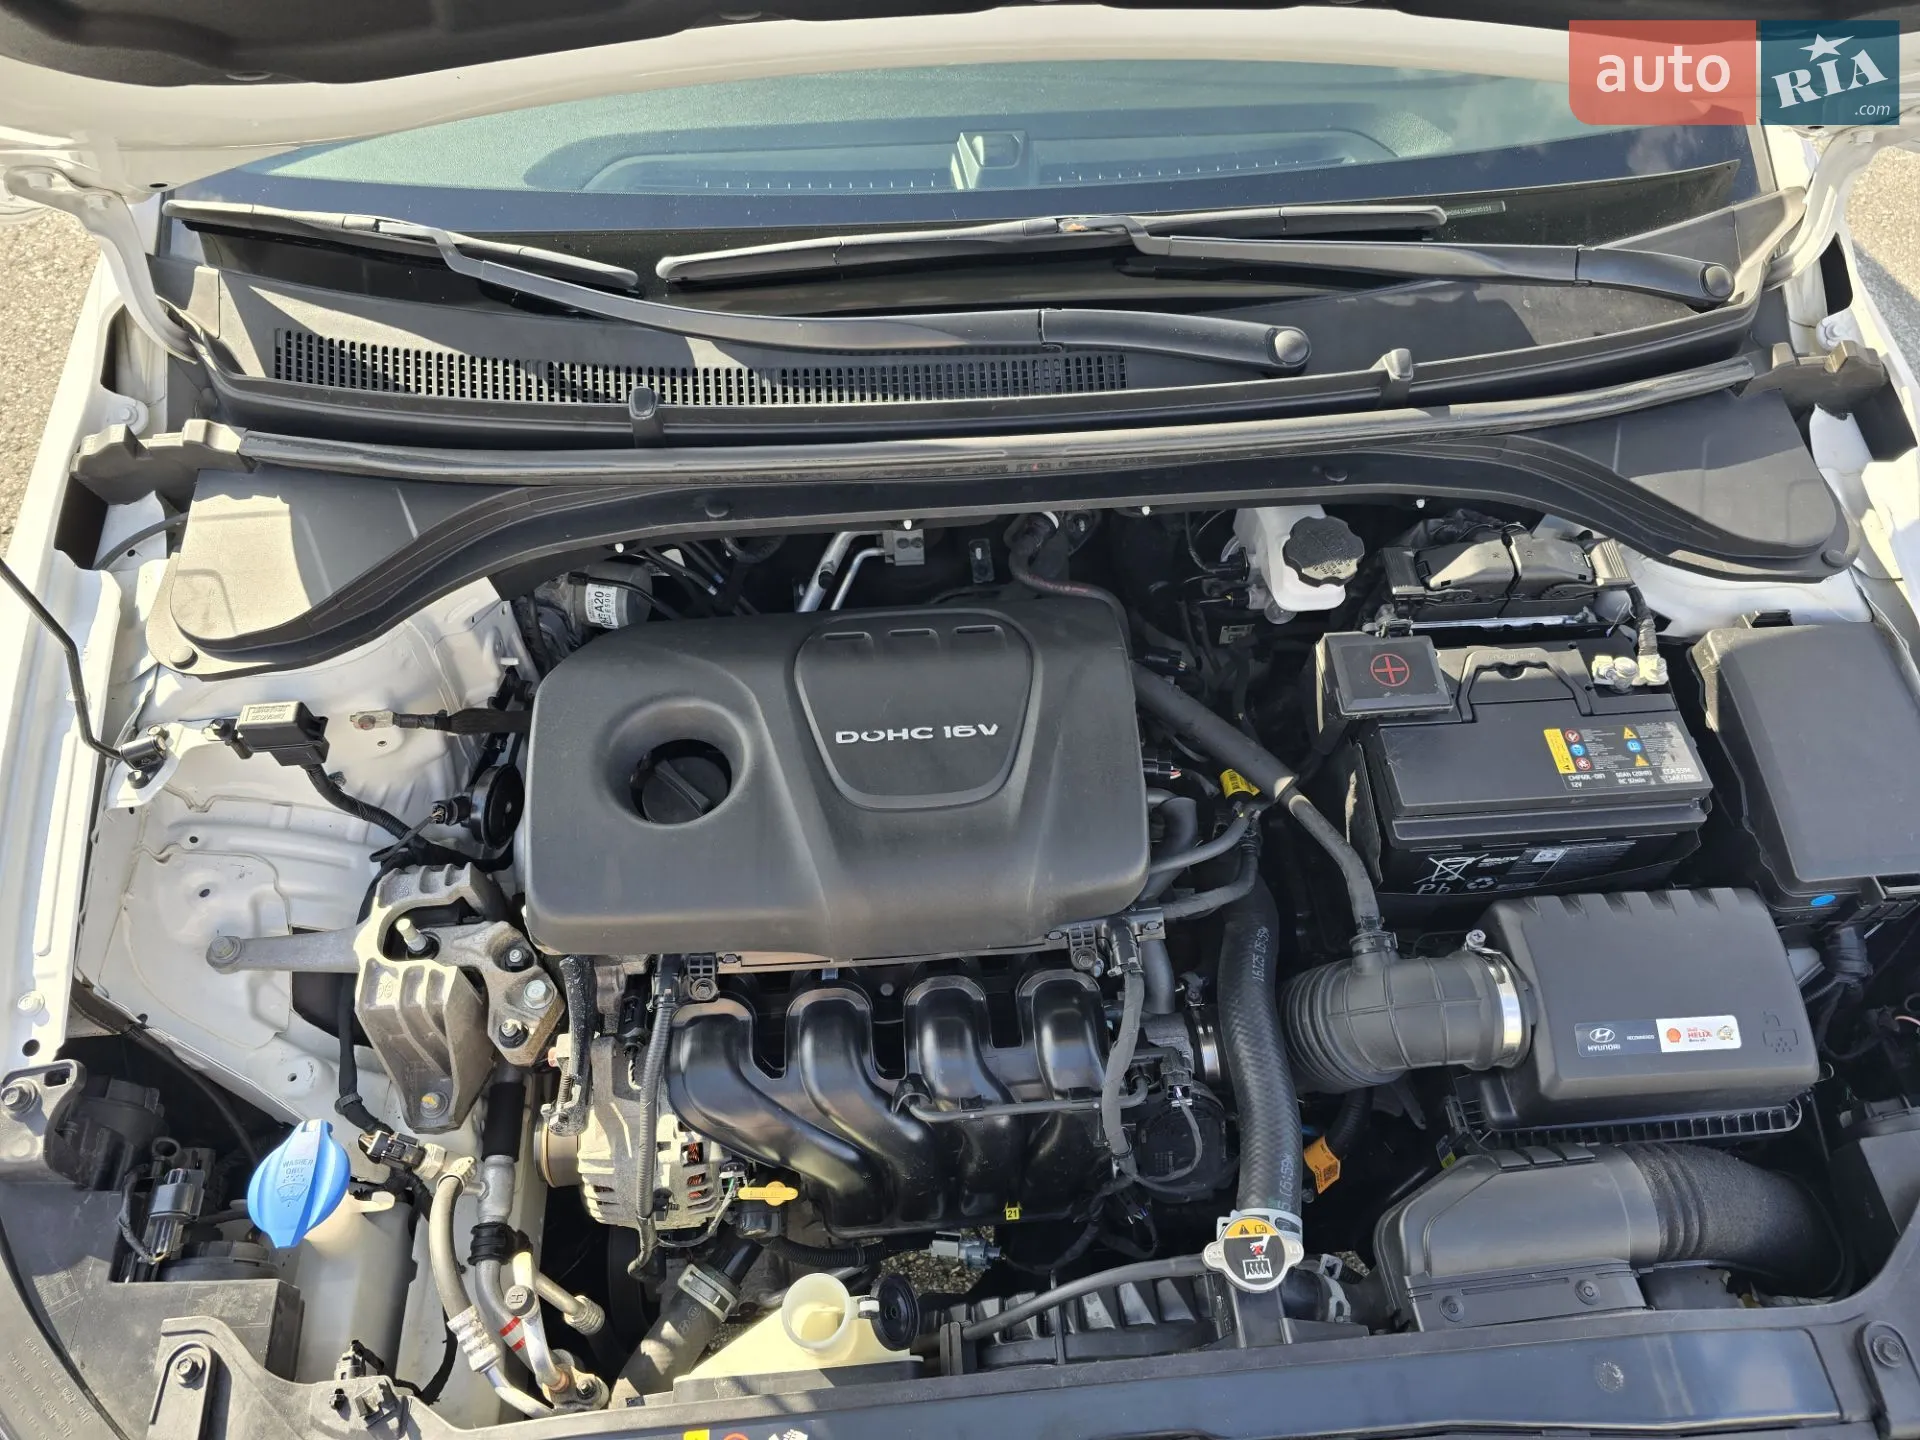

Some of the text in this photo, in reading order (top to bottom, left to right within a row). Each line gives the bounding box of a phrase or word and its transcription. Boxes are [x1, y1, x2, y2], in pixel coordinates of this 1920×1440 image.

[594, 591, 605, 613] A20
[835, 723, 999, 744] DOHC 16V
[1416, 883, 1451, 895] Pb
[1687, 1030, 1713, 1039] HELIX
[1587, 1044, 1621, 1052] HYUNDAI
[282, 1159, 314, 1169] WASHER
[285, 1167, 305, 1176] ONLY
[1007, 1210, 1017, 1219] 21
